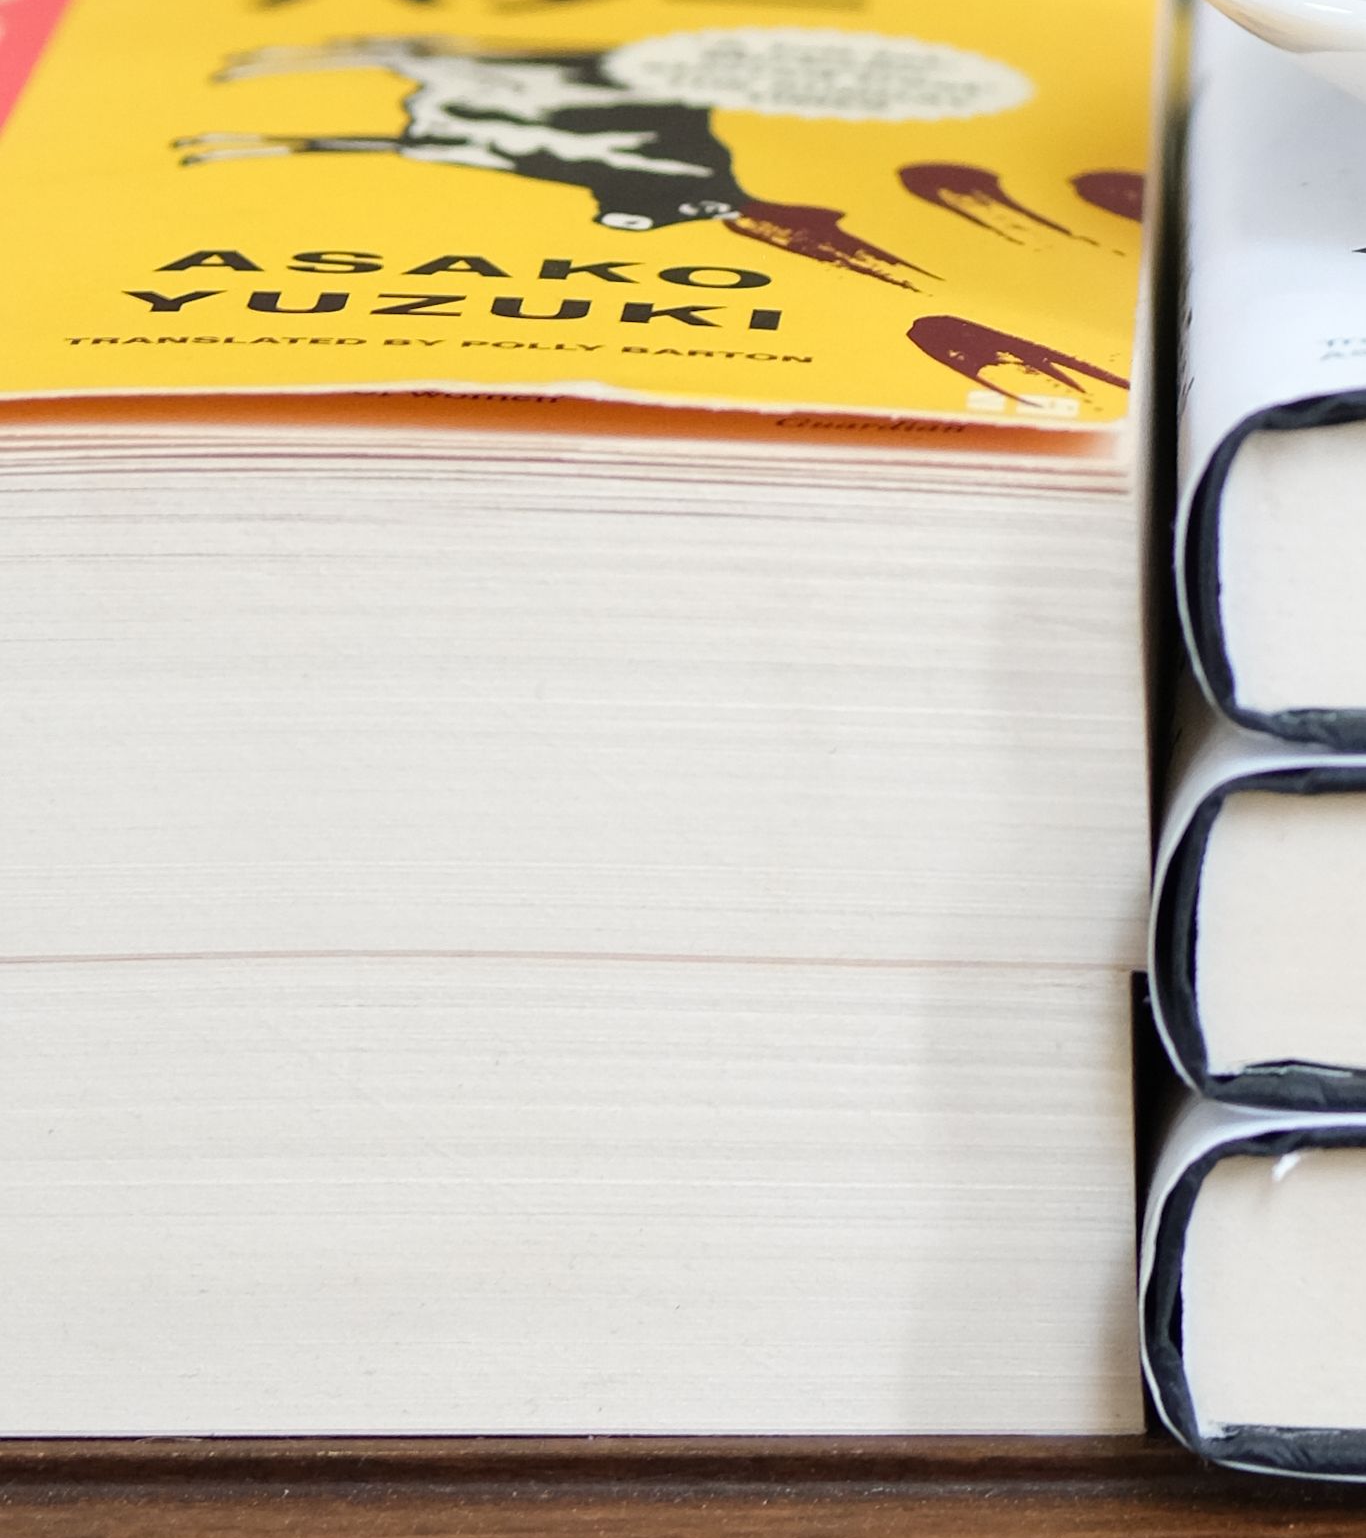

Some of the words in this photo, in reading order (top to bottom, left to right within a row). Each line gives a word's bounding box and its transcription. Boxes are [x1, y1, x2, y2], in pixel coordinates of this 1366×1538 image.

[153, 250, 772, 289] ASAKO
[122, 290, 783, 331] YUZUKI
[65, 336, 367, 346] TRANSLATED
[383, 338, 446, 347] BY
[461, 340, 605, 352] POLLY
[621, 346, 814, 364] BARTON
